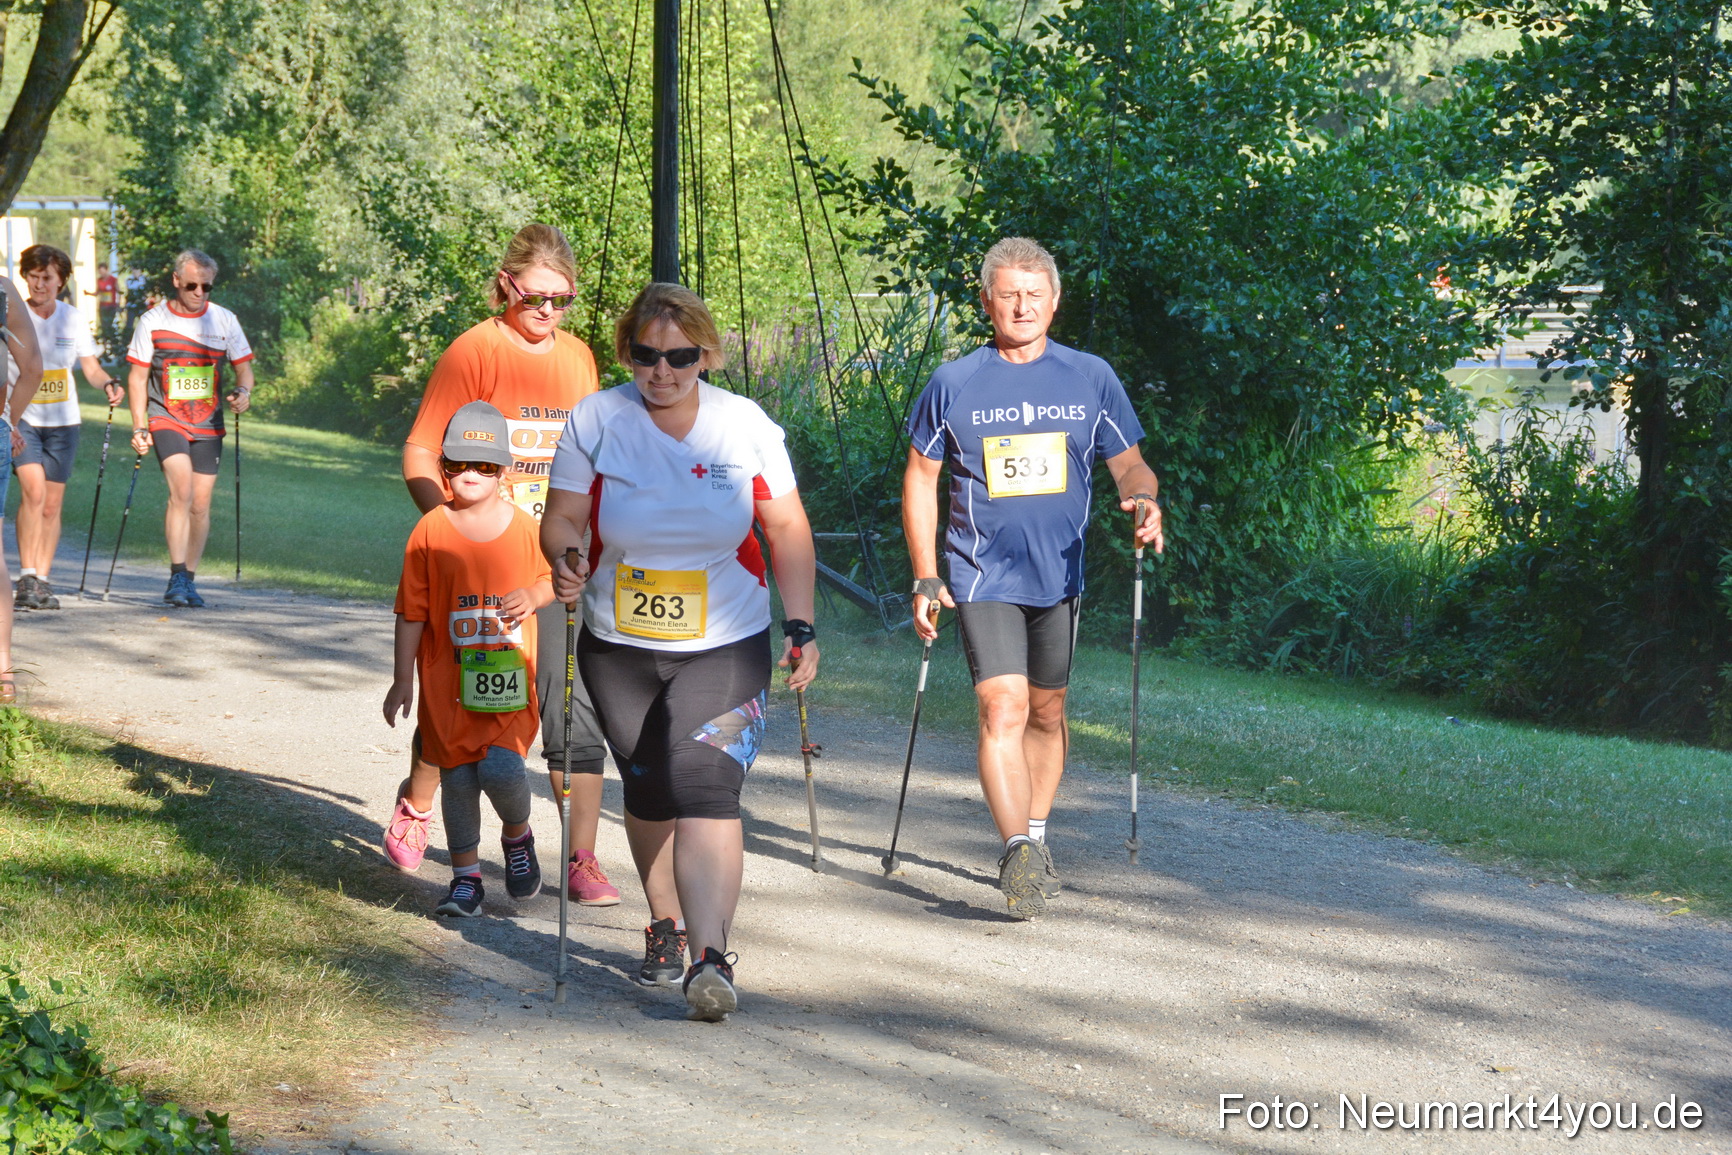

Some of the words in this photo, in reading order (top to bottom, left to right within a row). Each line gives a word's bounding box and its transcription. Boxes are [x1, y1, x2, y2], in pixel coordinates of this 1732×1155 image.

[36, 381, 64, 393] 409
[175, 378, 209, 390] 1885
[520, 406, 540, 418] 30
[972, 407, 1020, 425] EURO
[1037, 405, 1086, 421] POLES
[463, 430, 495, 443] OBI
[509, 461, 550, 475] eum
[711, 481, 734, 490] Elena
[458, 594, 478, 608] 30
[632, 592, 684, 620] 263
[453, 616, 513, 638] OBI
[667, 620, 688, 628] Elena
[475, 672, 518, 696] 894
